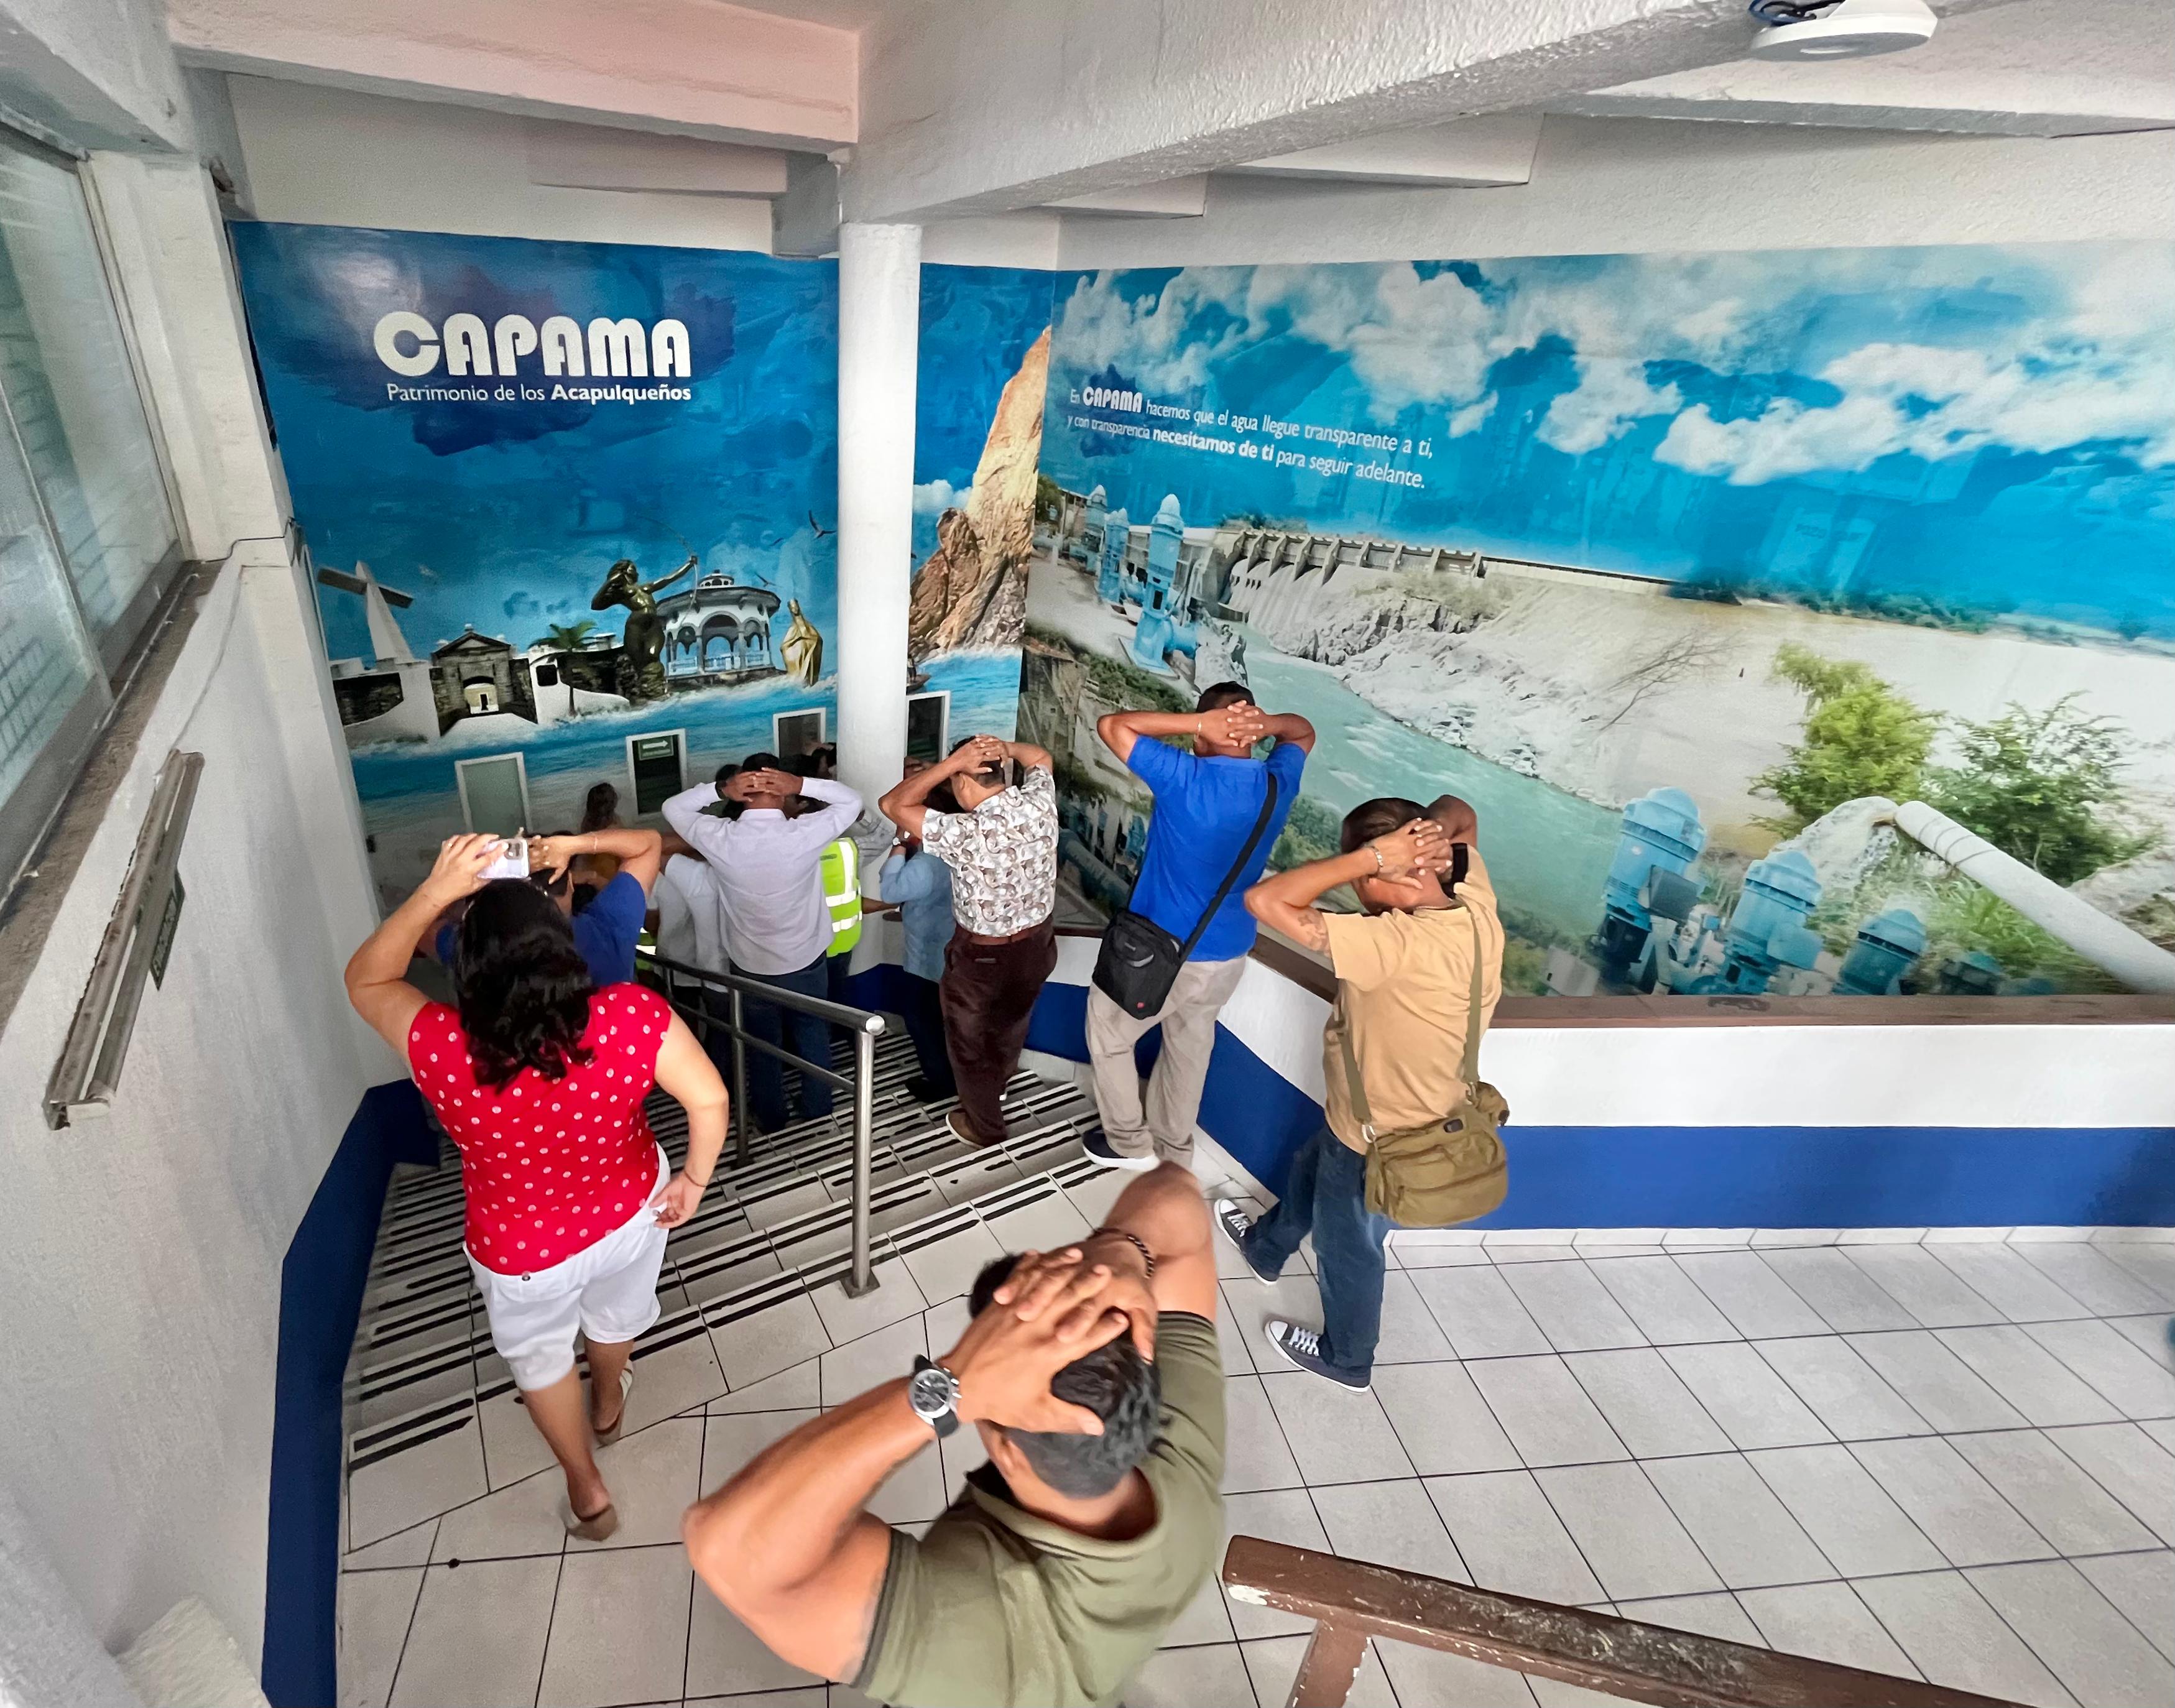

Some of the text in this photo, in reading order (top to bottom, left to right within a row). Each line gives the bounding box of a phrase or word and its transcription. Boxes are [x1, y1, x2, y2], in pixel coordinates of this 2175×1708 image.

[373, 310, 691, 377] CAPAMA
[387, 383, 691, 405] Patrimonio de los Acapulqueños
[1070, 386, 1433, 459] En CAPAMA hacemos que el agua llegue transparente a ti,
[1067, 415, 1425, 489] y con transparencia necesitamos de ti para seguir adelante.
